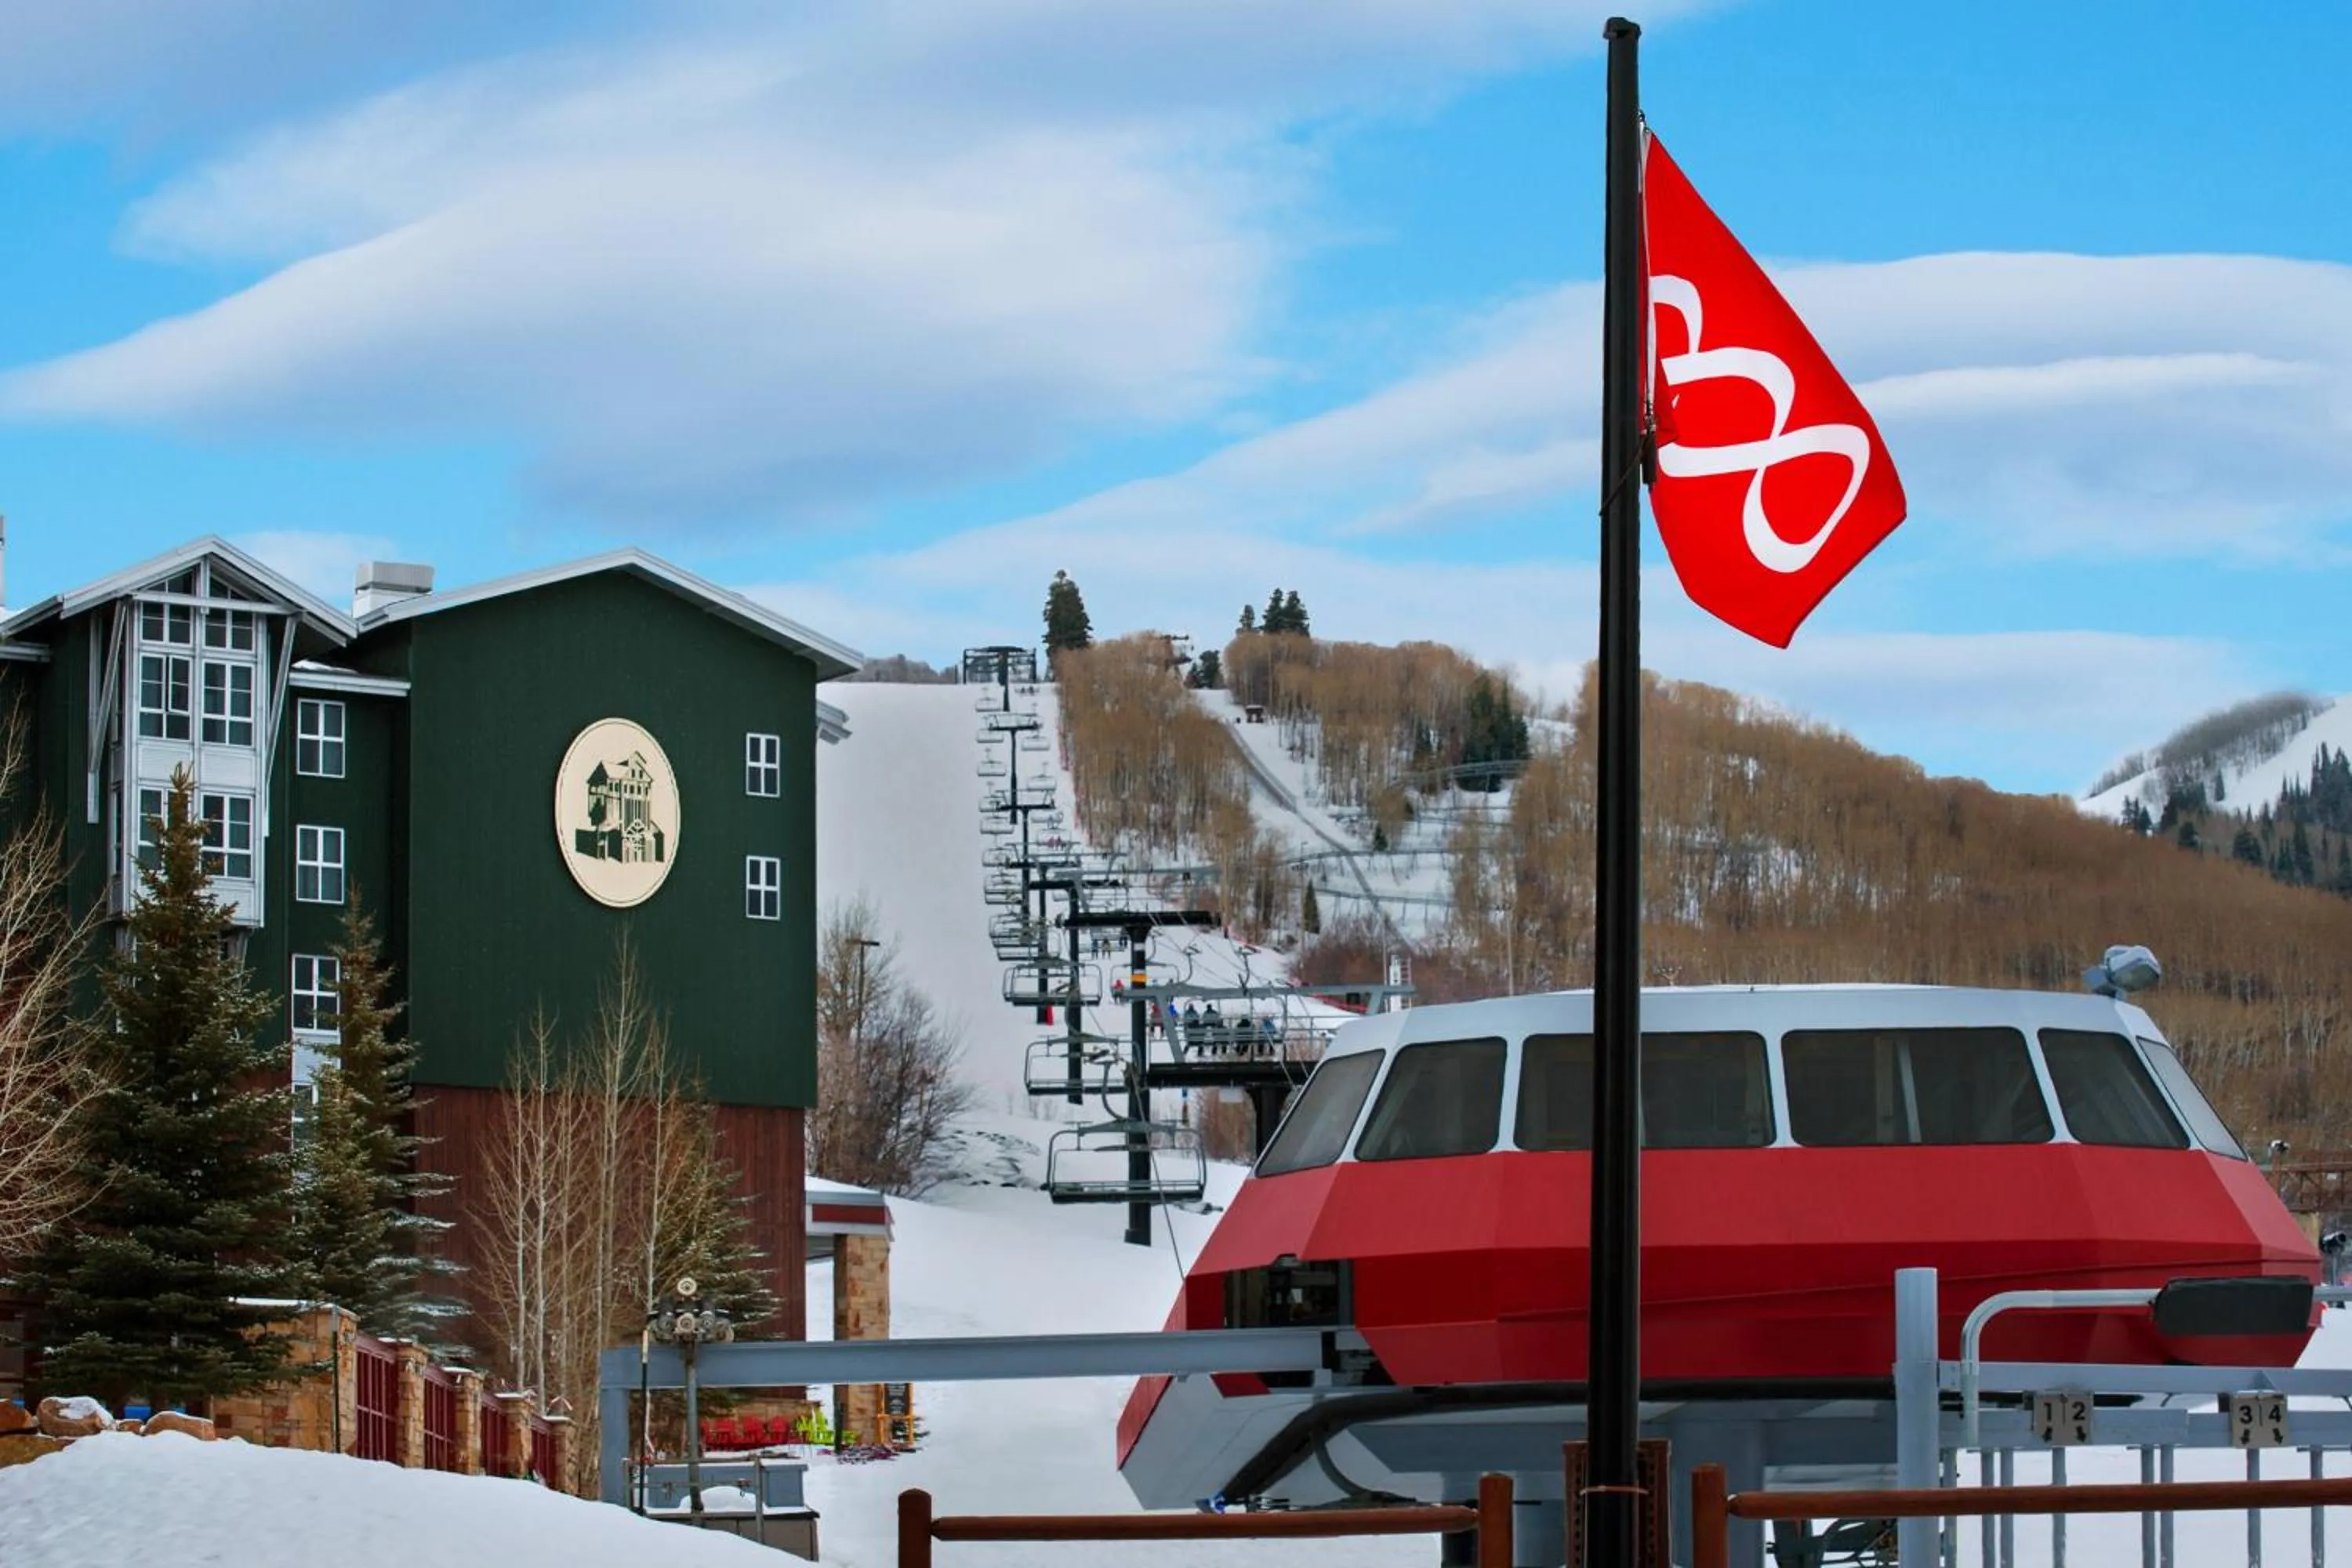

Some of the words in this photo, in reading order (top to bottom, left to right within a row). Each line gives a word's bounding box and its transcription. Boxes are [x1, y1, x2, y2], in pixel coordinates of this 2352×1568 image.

[2043, 1402, 2053, 1422] 1
[2072, 1401, 2086, 1421] 2
[2239, 1405, 2252, 1425] 3
[2268, 1404, 2282, 1423] 4
